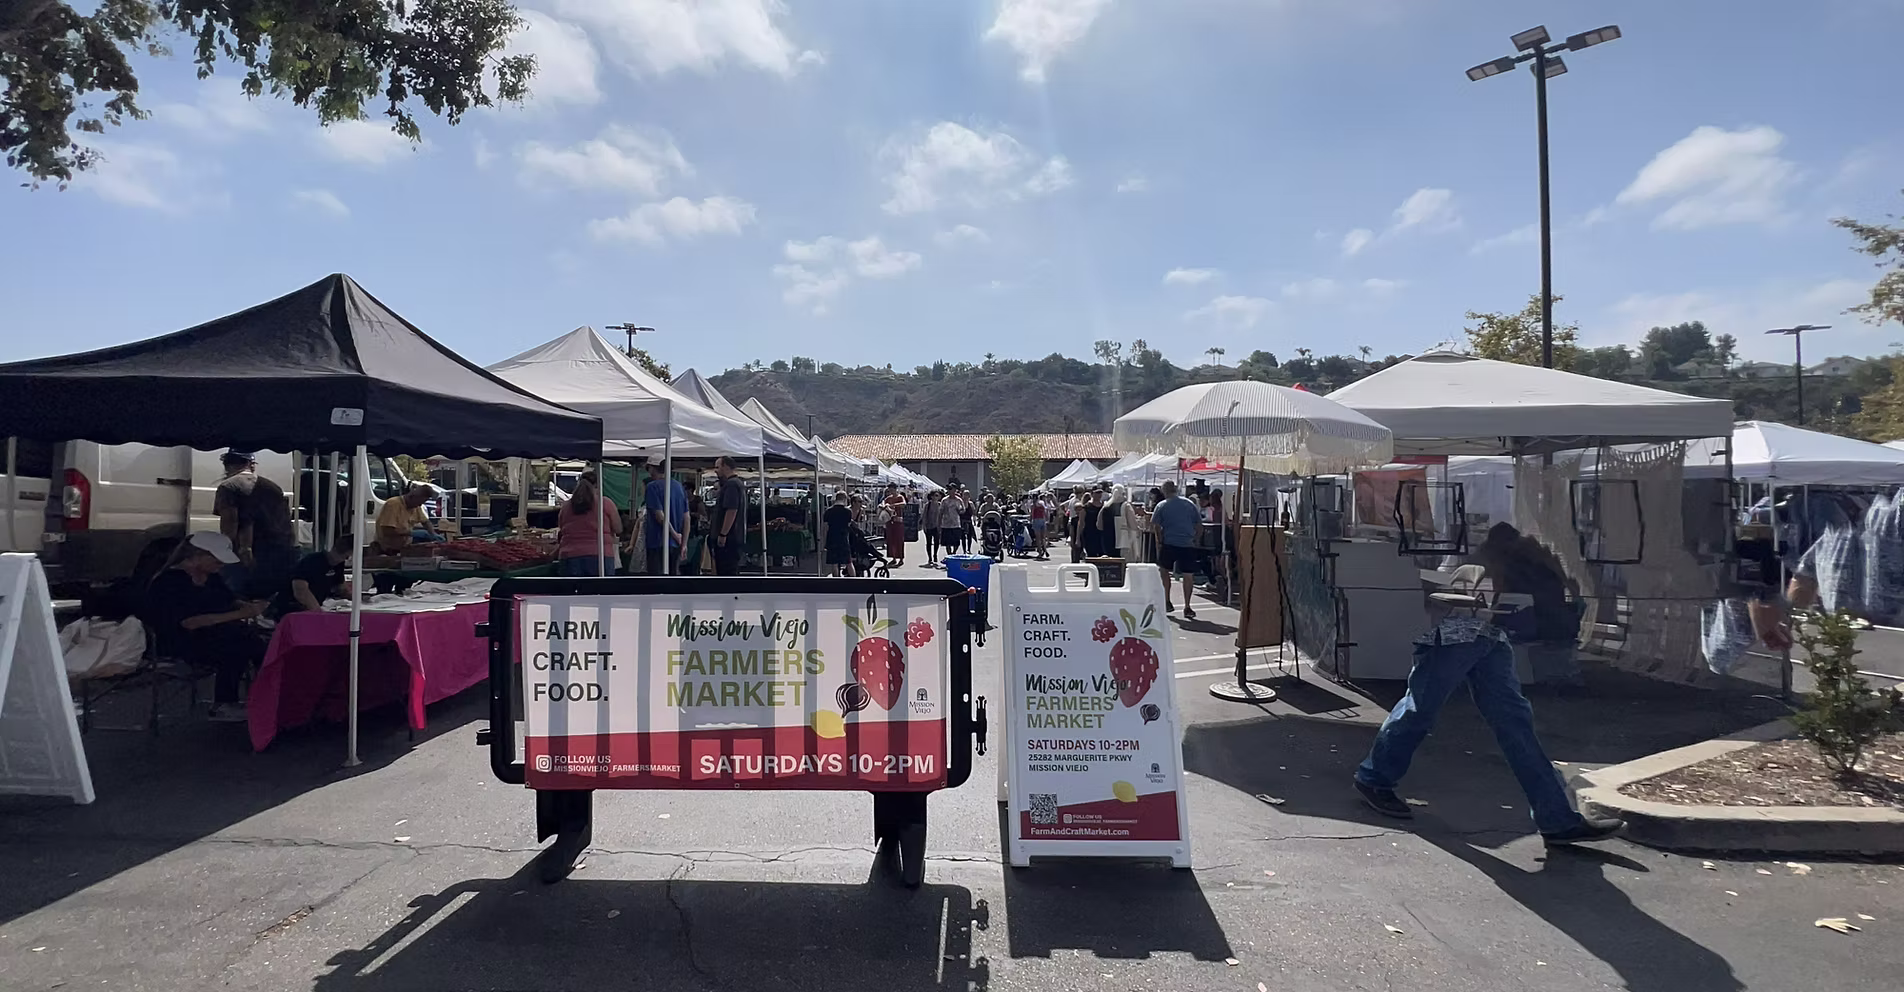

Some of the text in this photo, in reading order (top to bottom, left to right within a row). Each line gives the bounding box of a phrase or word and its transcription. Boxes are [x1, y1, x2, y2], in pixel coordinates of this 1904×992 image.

[1023, 614, 1064, 625] FARM.
[533, 621, 607, 640] FARM.
[667, 612, 809, 649] Mission Viejo
[1023, 630, 1071, 641] CRAFT.
[1024, 647, 1067, 658] FOOD.
[533, 652, 617, 671] CRAFT.
[667, 650, 825, 676] FARMERS
[534, 683, 609, 702] FOOD.
[667, 681, 807, 707] MARKET
[1025, 673, 1130, 701] Mission Viejo
[1026, 696, 1114, 711] FARMERS
[1027, 714, 1105, 729] MARKET
[1027, 739, 1140, 751] SATURDAYS 10-2PM
[554, 755, 612, 764] FOLLOW US
[700, 754, 934, 774] SATURDAYS 10-2PM
[1054, 754, 1108, 762] MARGUERITE
[1109, 754, 1133, 762] PKWY
[554, 764, 682, 773] MISSIONVIEJO_FARMERSMARKET
[1028, 764, 1089, 772] MISSION VIEJO
[1030, 827, 1130, 836] FarmAndCraftMarket.com
